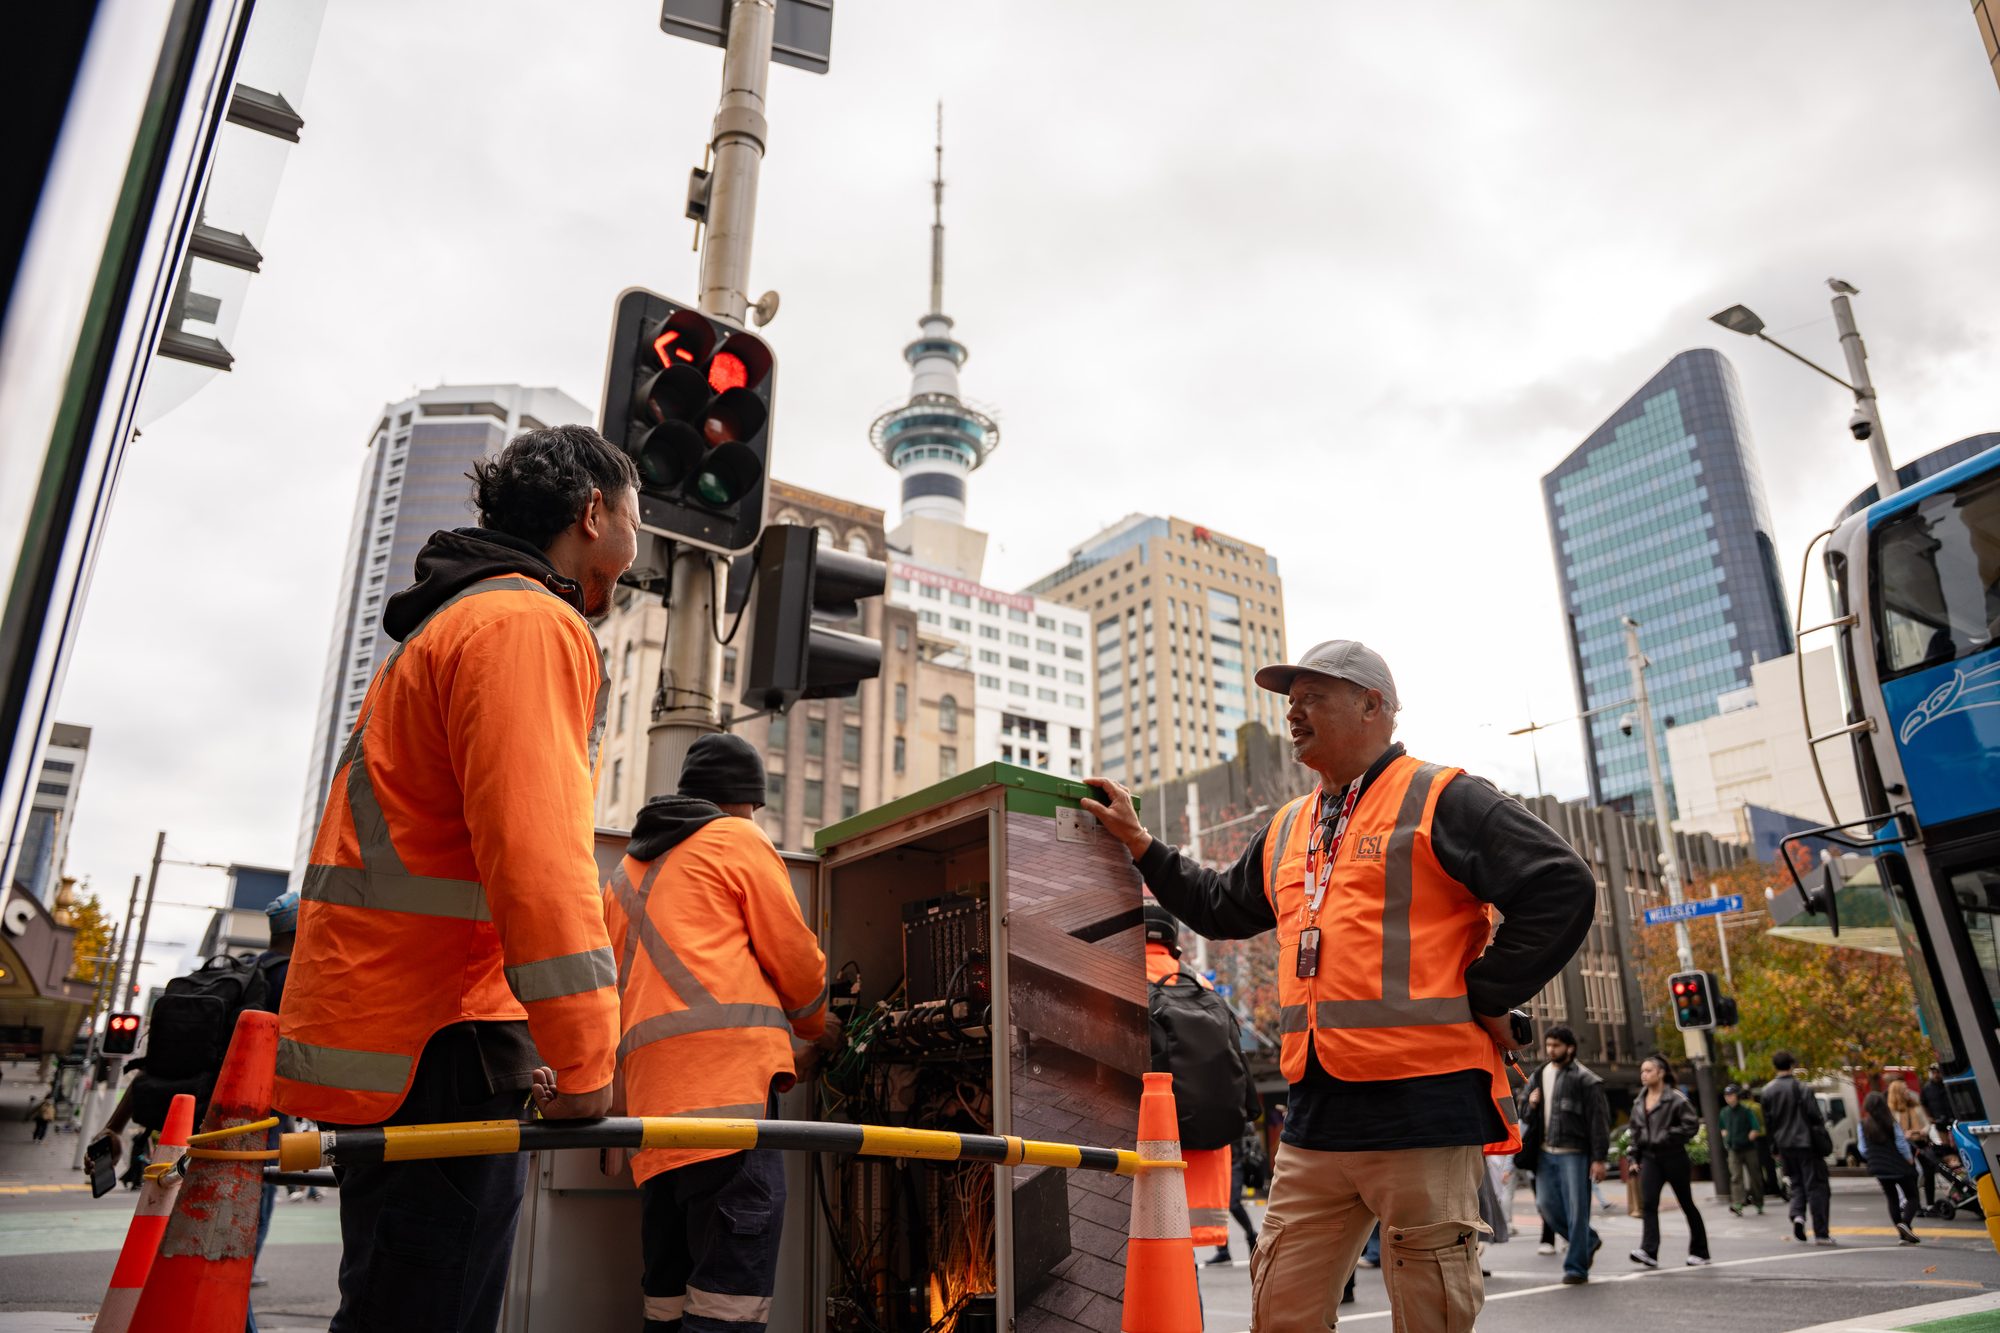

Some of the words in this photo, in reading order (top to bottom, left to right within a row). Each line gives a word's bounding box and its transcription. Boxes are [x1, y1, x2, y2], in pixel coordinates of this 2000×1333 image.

[957, 579, 994, 602] PLAZA
[995, 590, 1029, 610] HOTEL
[1358, 835, 1382, 854] CSL
[1648, 903, 1697, 922] WELLESLEY
